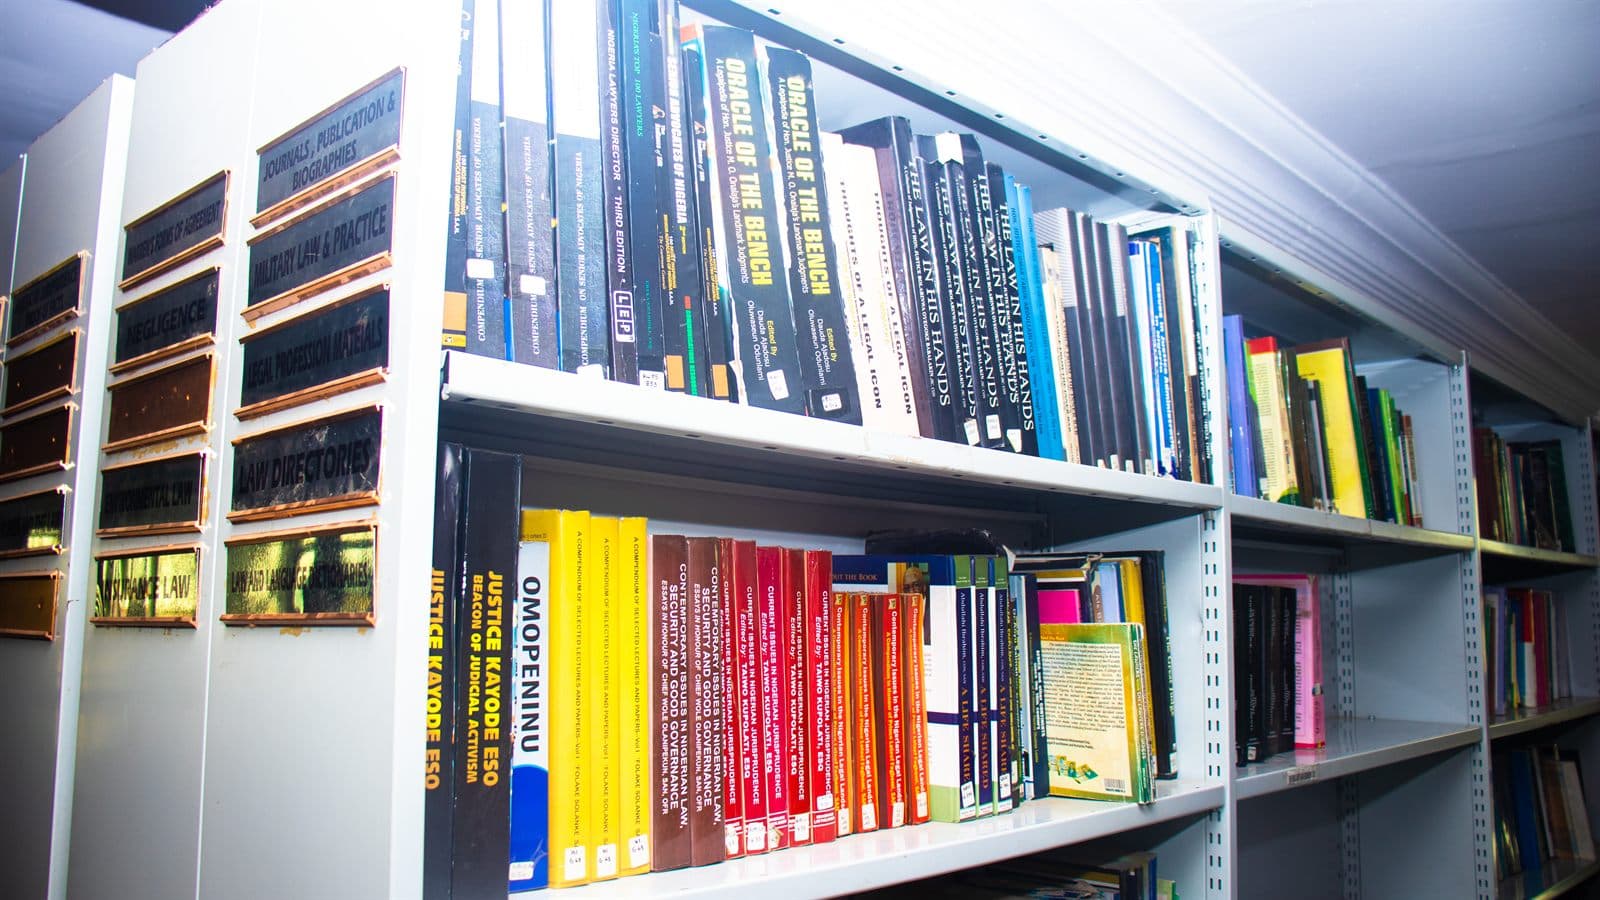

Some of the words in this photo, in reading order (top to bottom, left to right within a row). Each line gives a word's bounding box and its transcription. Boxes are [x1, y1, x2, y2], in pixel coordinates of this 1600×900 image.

[609, 73, 618, 124] LAWYERS
[715, 65, 727, 102] Legalpedia
[726, 58, 753, 135] ORACLE
[720, 104, 729, 112] of
[787, 77, 811, 152] ORACLE
[263, 139, 314, 182] JOURNALS,
[317, 97, 385, 152] PUBLICATION
[387, 90, 395, 112] &
[611, 127, 621, 180] DIRECTOR
[723, 131, 734, 154] Justice
[735, 141, 757, 167] OF
[292, 140, 357, 191] BIOGRAPHIES
[474, 157, 480, 168] OF
[727, 155, 735, 165] M.
[795, 158, 816, 182] OF
[908, 160, 919, 200] THE
[474, 171, 482, 222] ADVOCATES
[728, 176, 740, 208] Onalaja's
[738, 172, 763, 208] THE
[798, 187, 819, 223] THE
[615, 195, 624, 227] THIRD
[734, 210, 745, 244] Landmark
[915, 207, 929, 254] LAW
[254, 246, 296, 288] MILITARY
[297, 235, 321, 270] LAW
[323, 231, 330, 258] &
[333, 204, 387, 254] PRACTICE
[475, 224, 483, 258] SENIOR
[616, 230, 625, 273] EDITION
[744, 216, 773, 285] BENCH
[803, 229, 831, 294] BENCH
[737, 246, 749, 283] Judgments
[922, 260, 933, 281] IN
[126, 298, 207, 346] NEGLIGENCE
[477, 279, 485, 341] COMPENDIUM
[757, 310, 766, 334] Dauda
[926, 289, 940, 324] HIS
[747, 301, 759, 341] Oluwaseun
[753, 344, 764, 380] Odunlami
[761, 337, 771, 367] Ajadosu
[767, 320, 776, 344] Edited
[771, 346, 778, 356] By
[808, 309, 819, 349] Oluwaseun
[815, 350, 826, 385] Odunlami
[817, 319, 825, 341] Dauda
[821, 344, 831, 373] Ajadosu
[826, 328, 836, 351] Edited
[830, 353, 838, 362] By
[862, 314, 873, 363] LEGAL
[870, 369, 882, 409] ICON
[931, 331, 950, 407] HANDS
[239, 460, 271, 494] LAW
[272, 438, 372, 488] DIRECTORIES
[429, 568, 444, 649] JUSTICE
[472, 574, 483, 629] BEACON
[486, 571, 503, 651] JUSTICE
[662, 612, 668, 621] IN
[670, 584, 678, 647] SECURITY
[702, 588, 710, 648] SECURITY
[711, 567, 719, 668] CONTEMPORARY
[470, 633, 481, 652] OF
[670, 649, 679, 677] AND
[468, 654, 481, 715] JUDICIAL
[521, 576, 540, 753] OMOPENINU
[662, 659, 668, 670] OF
[703, 651, 711, 677] AND
[726, 665, 731, 674] IN
[749, 668, 755, 677] IN
[426, 655, 443, 742] KAYODE
[484, 656, 501, 741] KAYODE
[670, 680, 678, 717] GOOD
[703, 680, 712, 717] GOOD
[838, 696, 843, 704] in
[680, 720, 687, 731] IN
[714, 720, 720, 731] IN
[425, 748, 440, 791] ESO
[467, 719, 478, 783] ACTIVISM
[483, 746, 499, 787] ESO
[670, 721, 679, 810] GOVERNANCE
[704, 720, 712, 806] GOVERNANCE
[727, 725, 735, 804] JURISPRUDENCE
[751, 727, 759, 805] JURISPRUDENCE
[713, 796, 721, 826] LAW,
